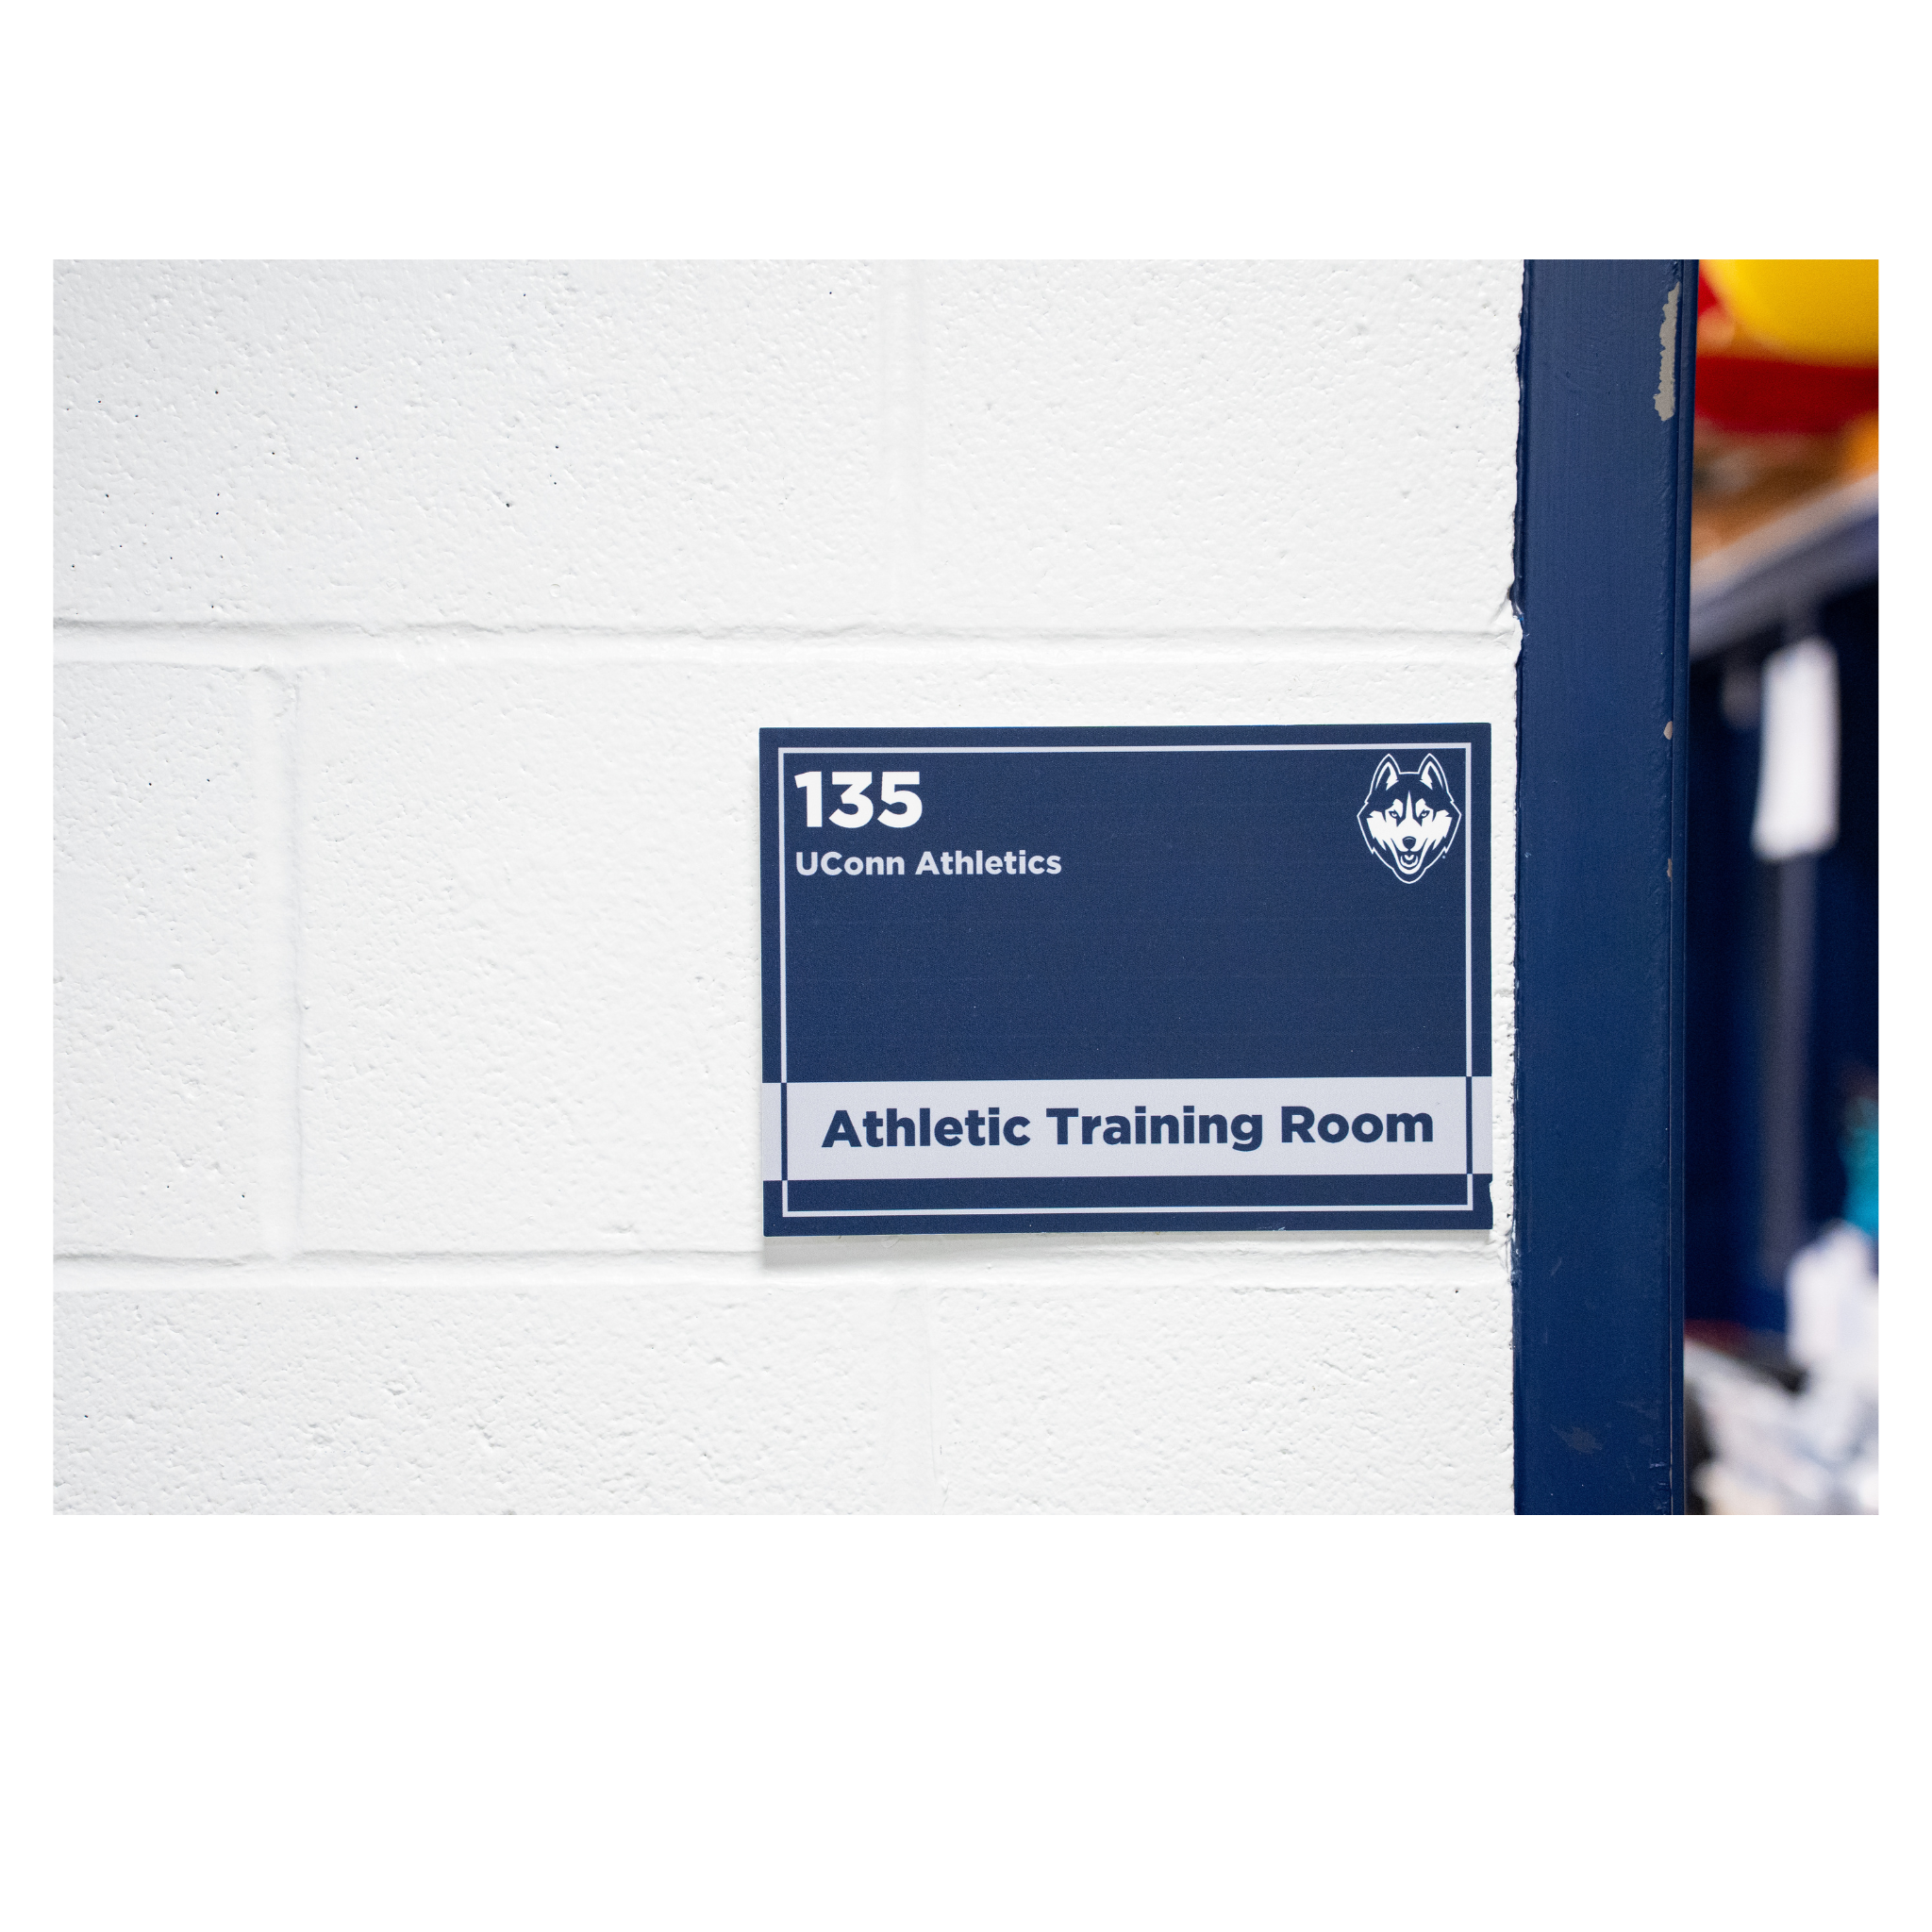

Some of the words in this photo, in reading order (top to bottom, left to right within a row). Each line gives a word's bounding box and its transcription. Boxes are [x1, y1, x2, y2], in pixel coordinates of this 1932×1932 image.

[794, 771, 924, 829] 135
[795, 851, 906, 876] UConn
[914, 849, 1062, 875] Athletics
[821, 1107, 1031, 1148] Athletic
[1045, 1105, 1263, 1153] Training
[1280, 1106, 1434, 1144] Room
